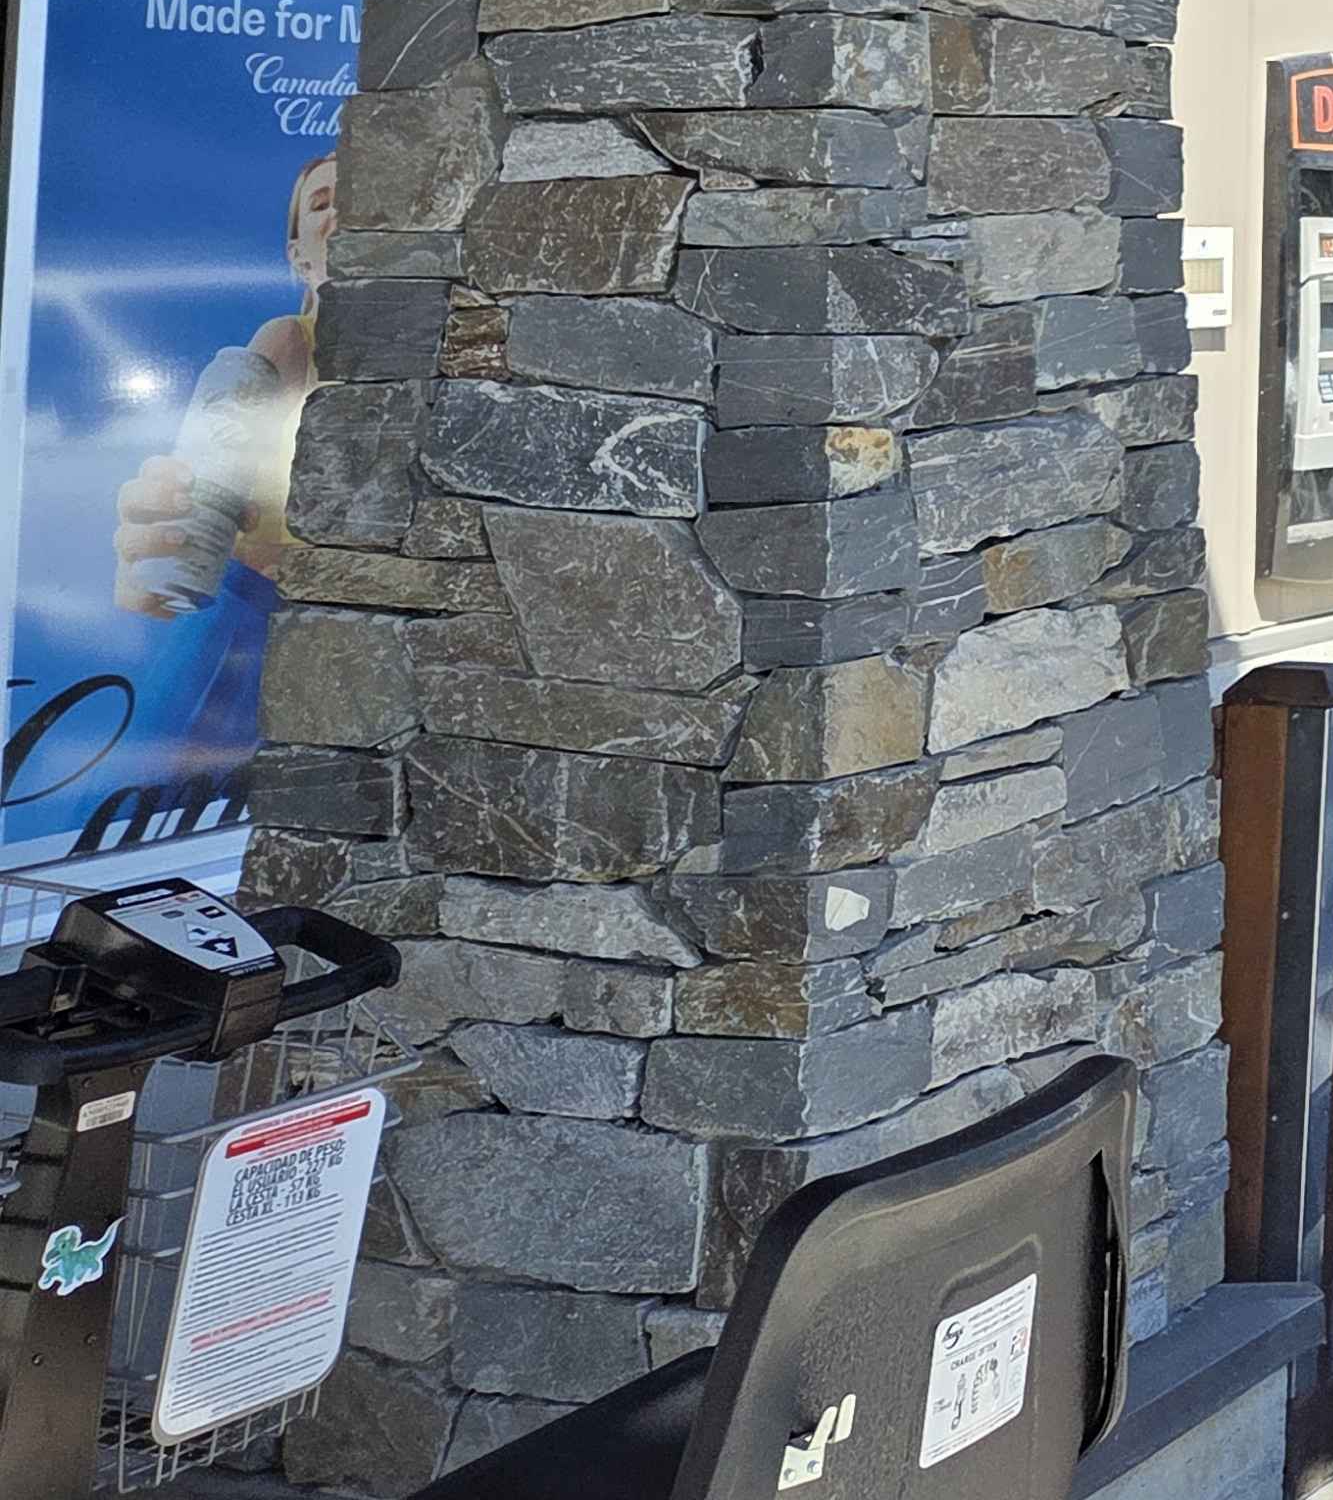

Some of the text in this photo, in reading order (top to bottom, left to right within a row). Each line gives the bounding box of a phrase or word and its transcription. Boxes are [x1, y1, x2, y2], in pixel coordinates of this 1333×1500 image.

[235, 1153, 297, 1183] CAPACIDAD
[299, 1146, 314, 1164] DE
[247, 1166, 297, 1193] USUARIO
[246, 1183, 278, 1208] CESTA
[226, 1205, 259, 1227] CESTA
